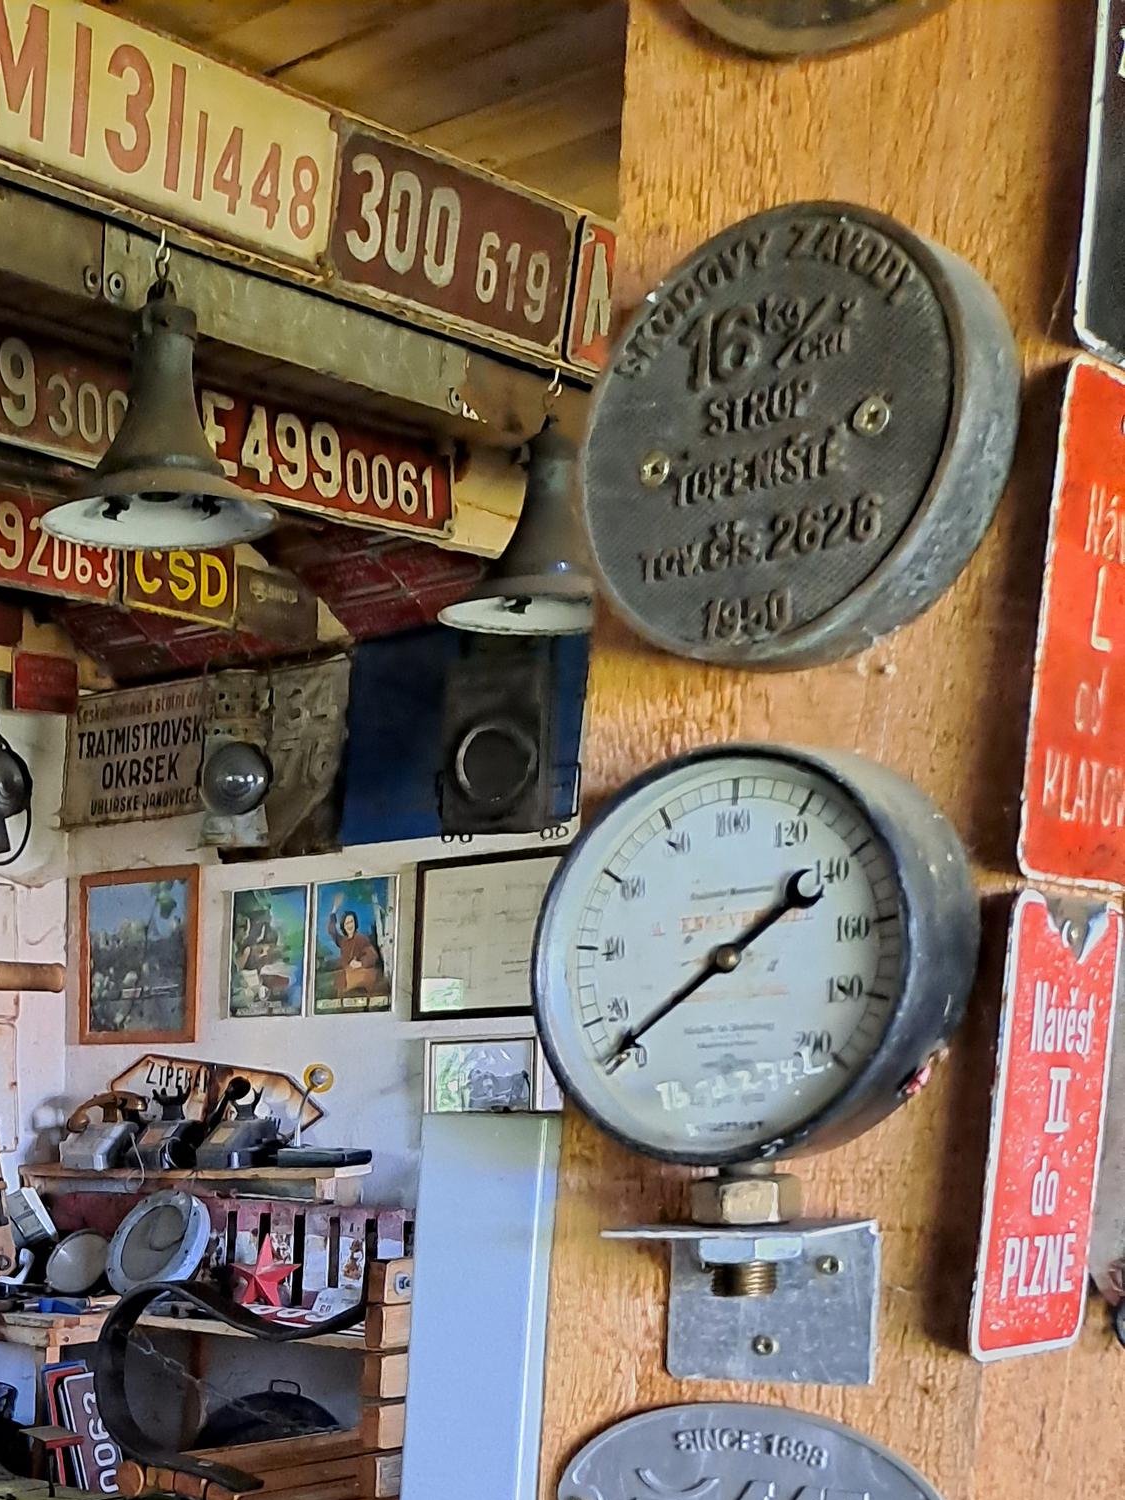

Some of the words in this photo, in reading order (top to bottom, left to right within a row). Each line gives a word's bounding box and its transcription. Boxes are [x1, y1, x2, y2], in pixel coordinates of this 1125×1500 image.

[345, 153, 461, 287] 300
[475, 230, 550, 324] 619
[102, 753, 180, 790] OKRSEK
[1030, 981, 1095, 1056] Návěst
[1031, 1156, 1059, 1218] do
[1001, 1220, 1076, 1300] PLZNĚ
[675, 1427, 761, 1455] SINCE
